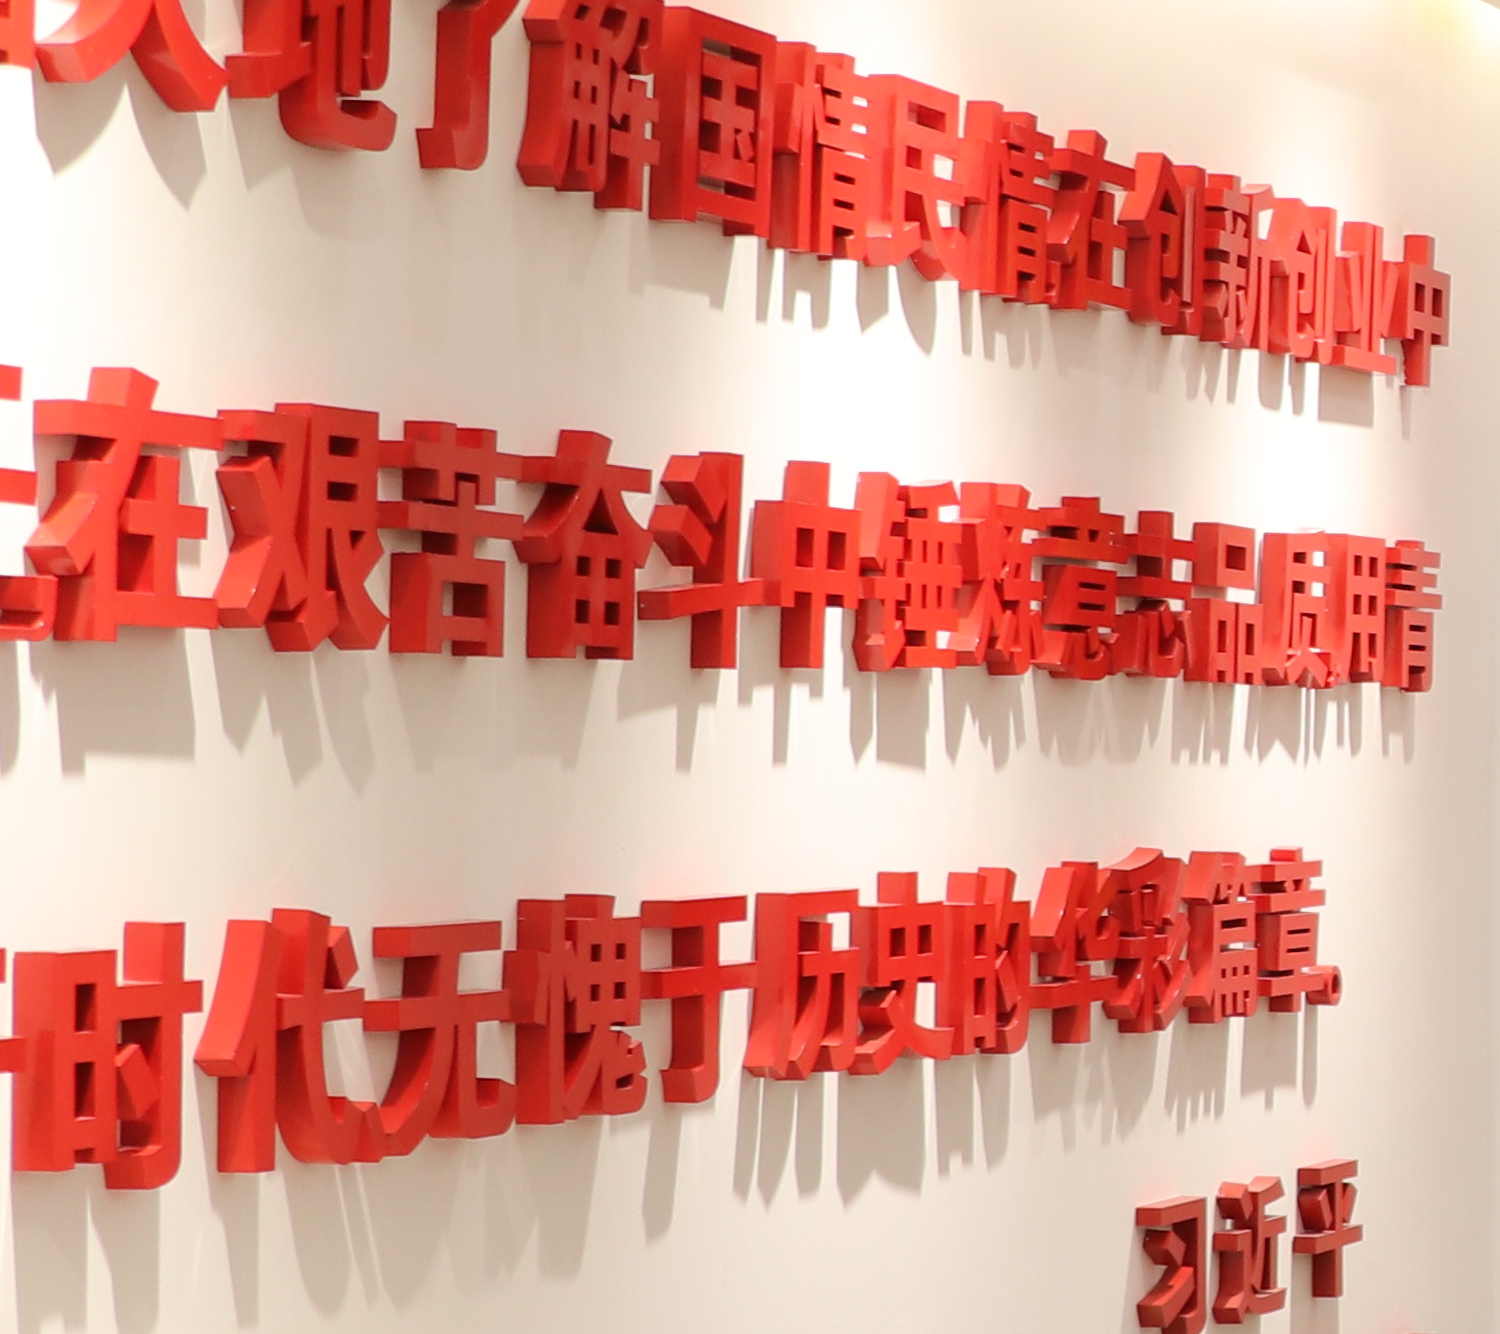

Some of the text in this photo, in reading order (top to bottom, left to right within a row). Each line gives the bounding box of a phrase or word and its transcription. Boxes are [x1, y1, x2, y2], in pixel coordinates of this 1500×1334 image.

[0, 364, 1442, 693] 在艰苦奋斗中锤炼意志品质用青
[0, 847, 1342, 1190] 时代无愧于历史的华彩篇章。
